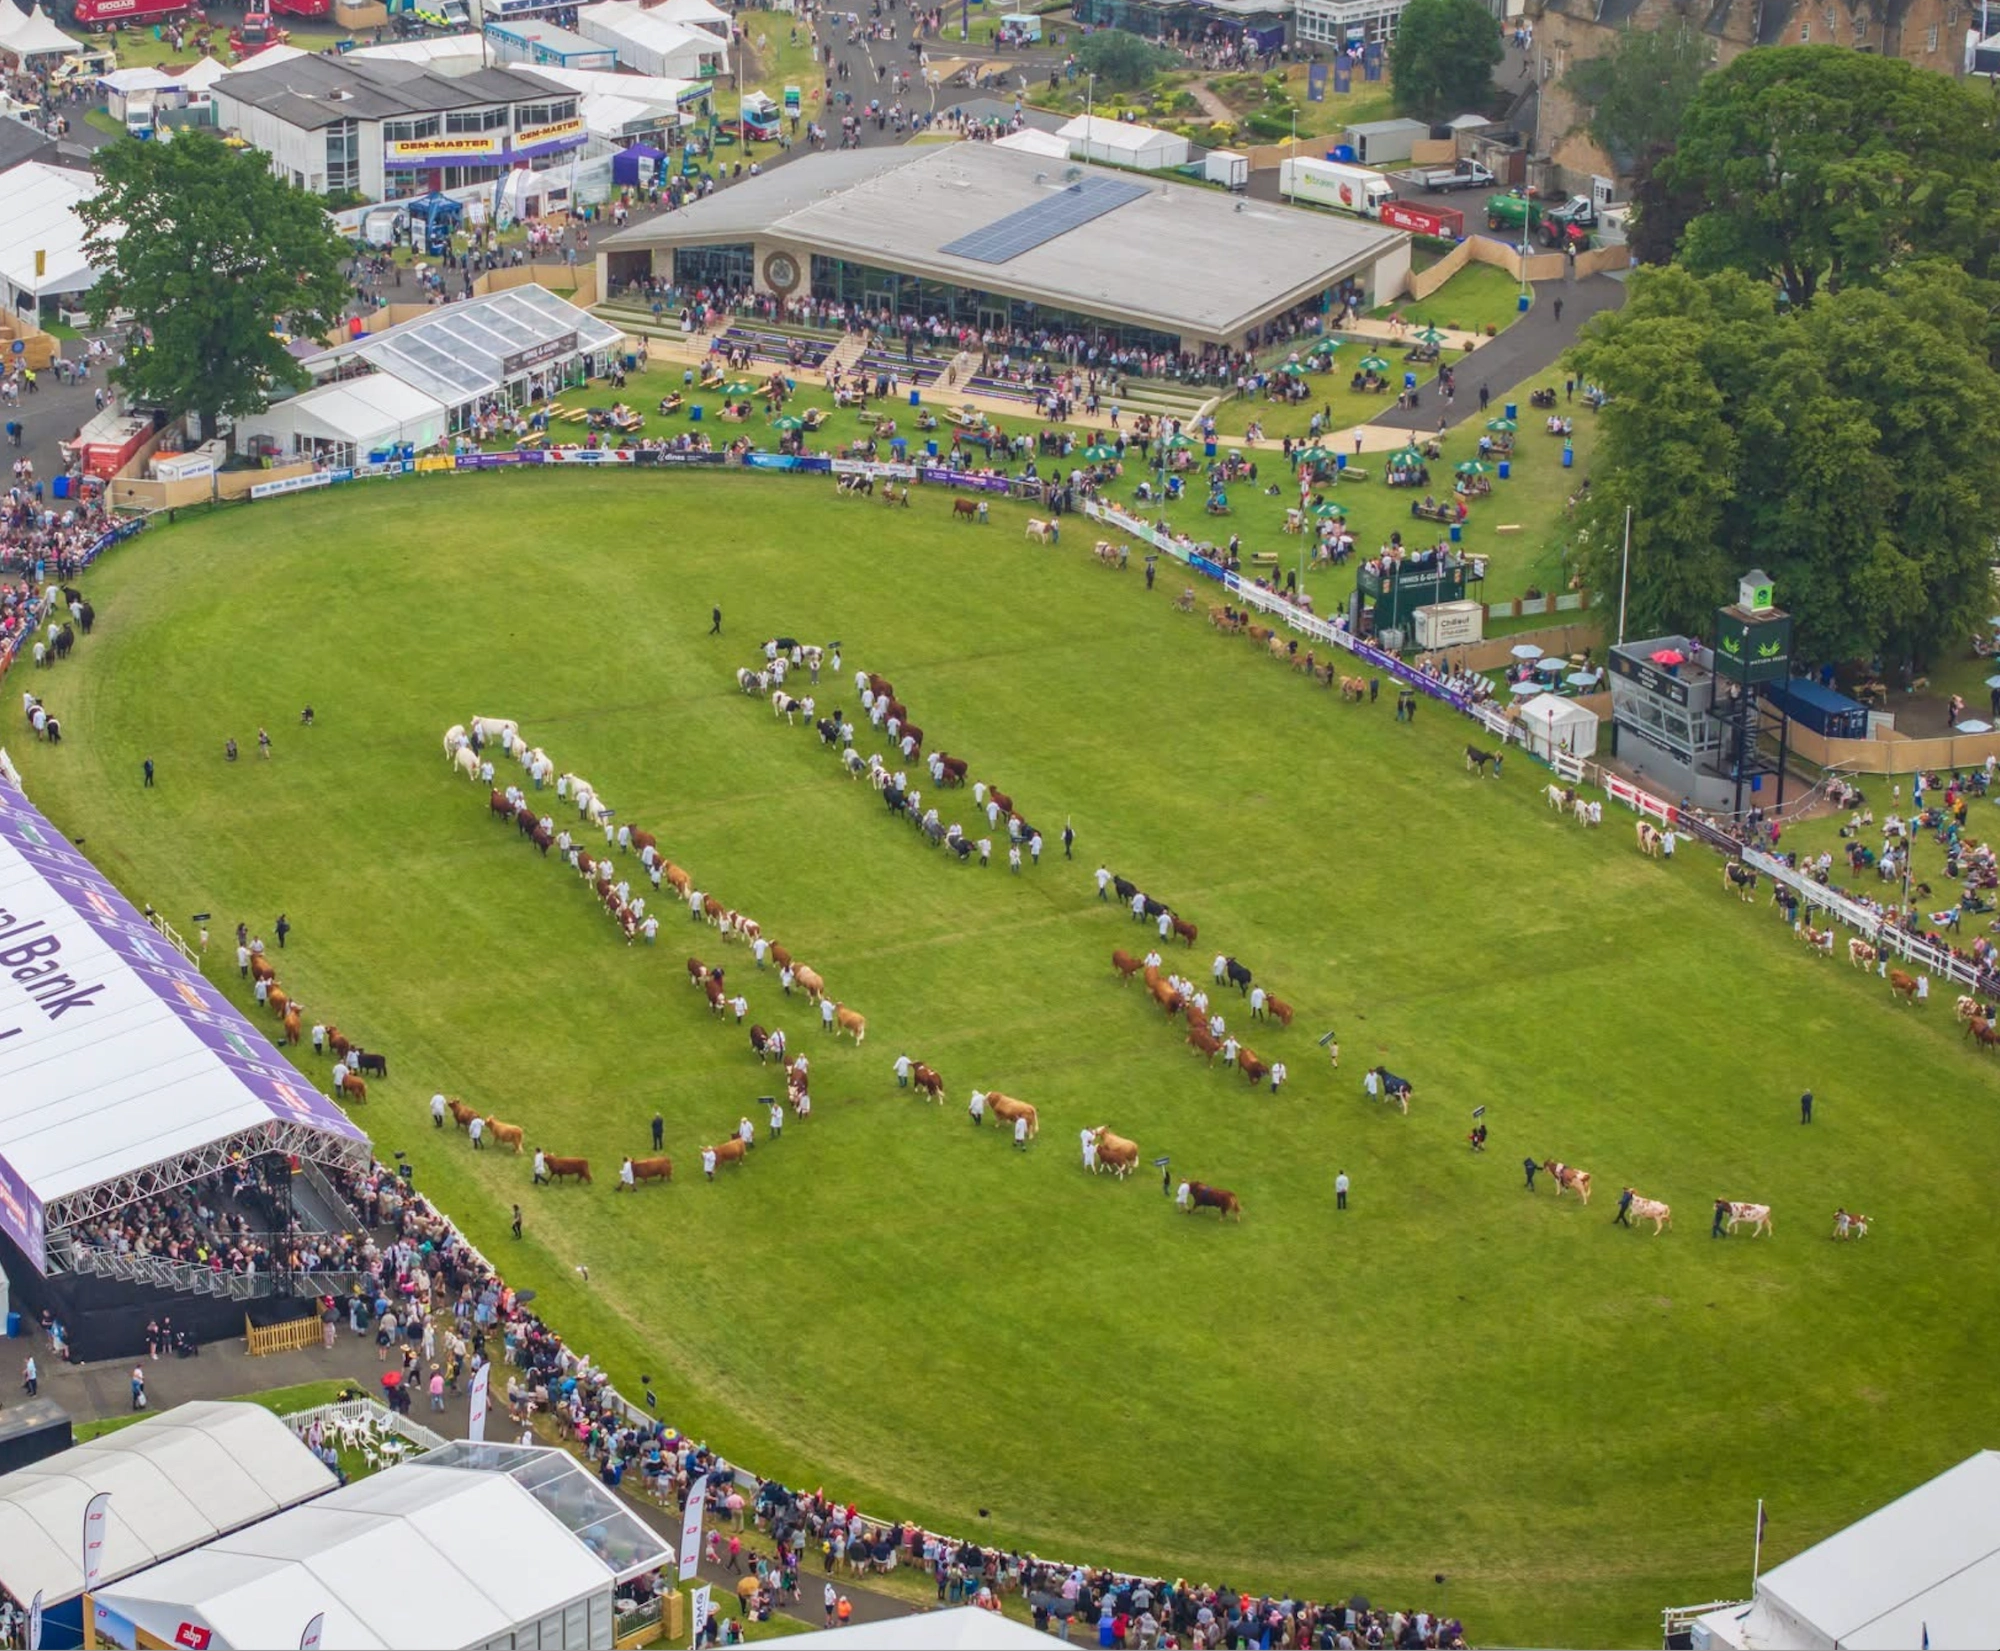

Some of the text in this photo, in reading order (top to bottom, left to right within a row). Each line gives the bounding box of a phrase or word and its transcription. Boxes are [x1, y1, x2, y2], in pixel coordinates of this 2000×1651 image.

[520, 120, 580, 140] DEM-MASTER
[400, 139, 489, 150] DEM-MASTER
[0, 934, 106, 1021] Bank
